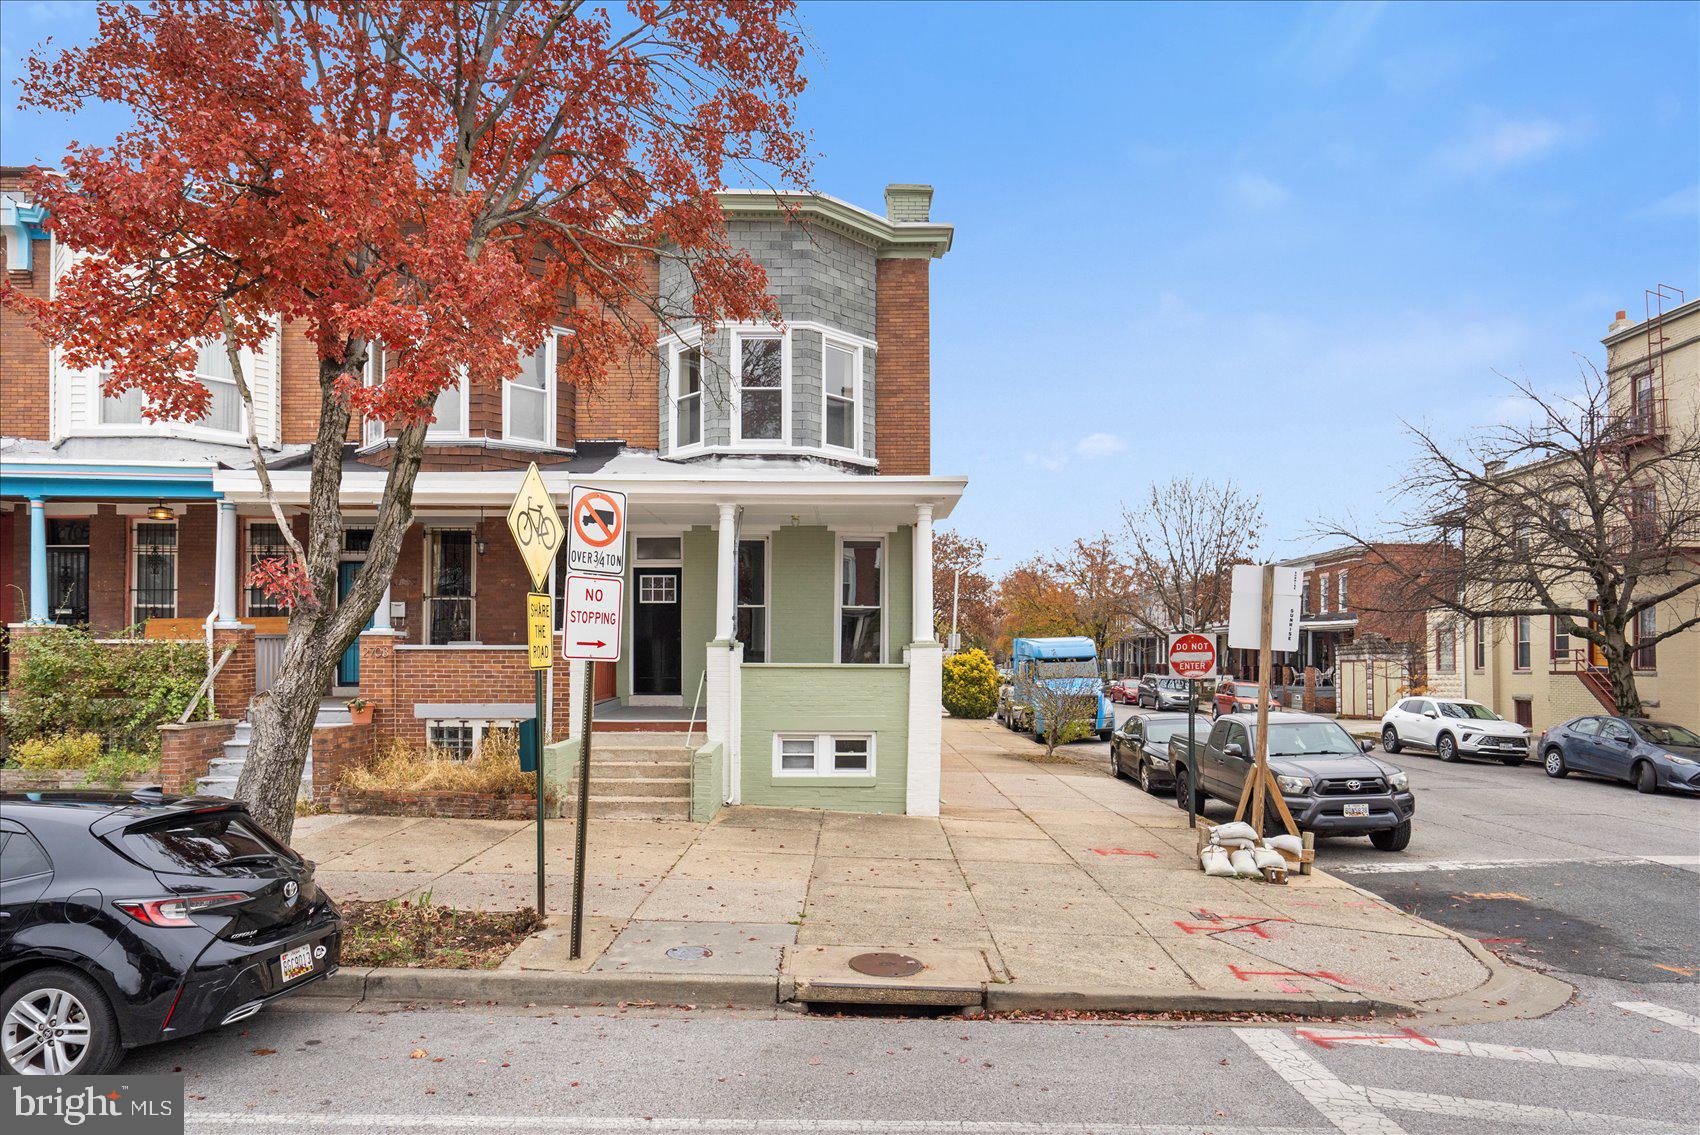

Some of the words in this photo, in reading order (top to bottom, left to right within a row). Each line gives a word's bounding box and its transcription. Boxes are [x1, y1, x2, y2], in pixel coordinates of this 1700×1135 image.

[571, 550, 593, 564] OVER
[606, 553, 622, 567] TON
[585, 588, 603, 602] NO
[530, 603, 550, 618] SHARE
[570, 610, 616, 626] STOPPING
[534, 624, 546, 639] THE
[533, 645, 549, 659] ROAD
[1176, 643, 1188, 651] DO
[1191, 642, 1208, 650] NOT
[1179, 662, 1206, 670] ENTER
